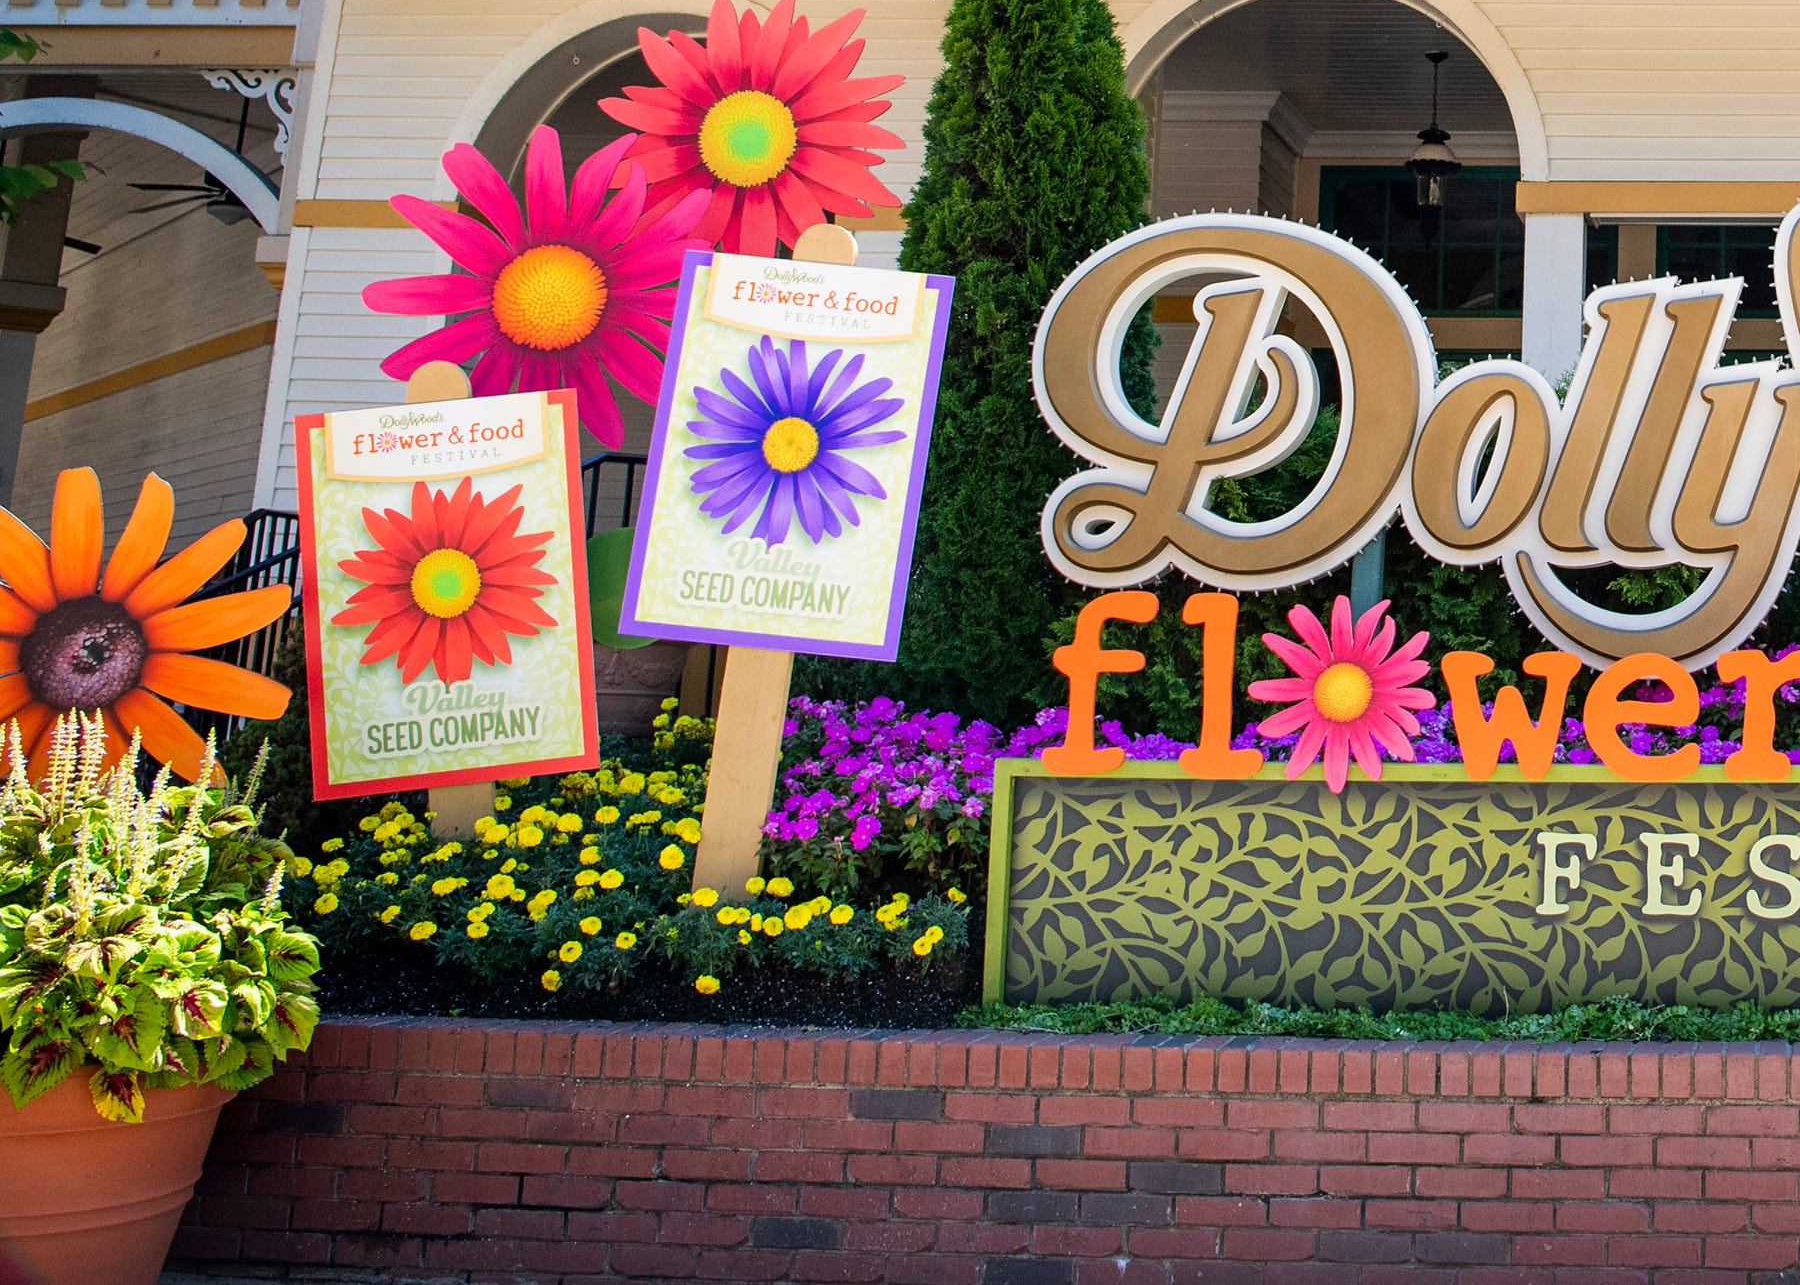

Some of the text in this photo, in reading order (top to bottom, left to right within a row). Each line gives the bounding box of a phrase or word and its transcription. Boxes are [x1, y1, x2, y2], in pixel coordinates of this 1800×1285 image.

[824, 290, 839, 308] &
[844, 292, 898, 315] food
[784, 311, 871, 329] FESTIVAL
[449, 426, 463, 443] &
[469, 419, 524, 443] food
[411, 447, 502, 465] FESTIVAL
[728, 540, 821, 586] Valley
[680, 570, 851, 614] SEED COMPANY
[407, 684, 506, 717] Valley
[367, 706, 540, 754] SEED COMPANY
